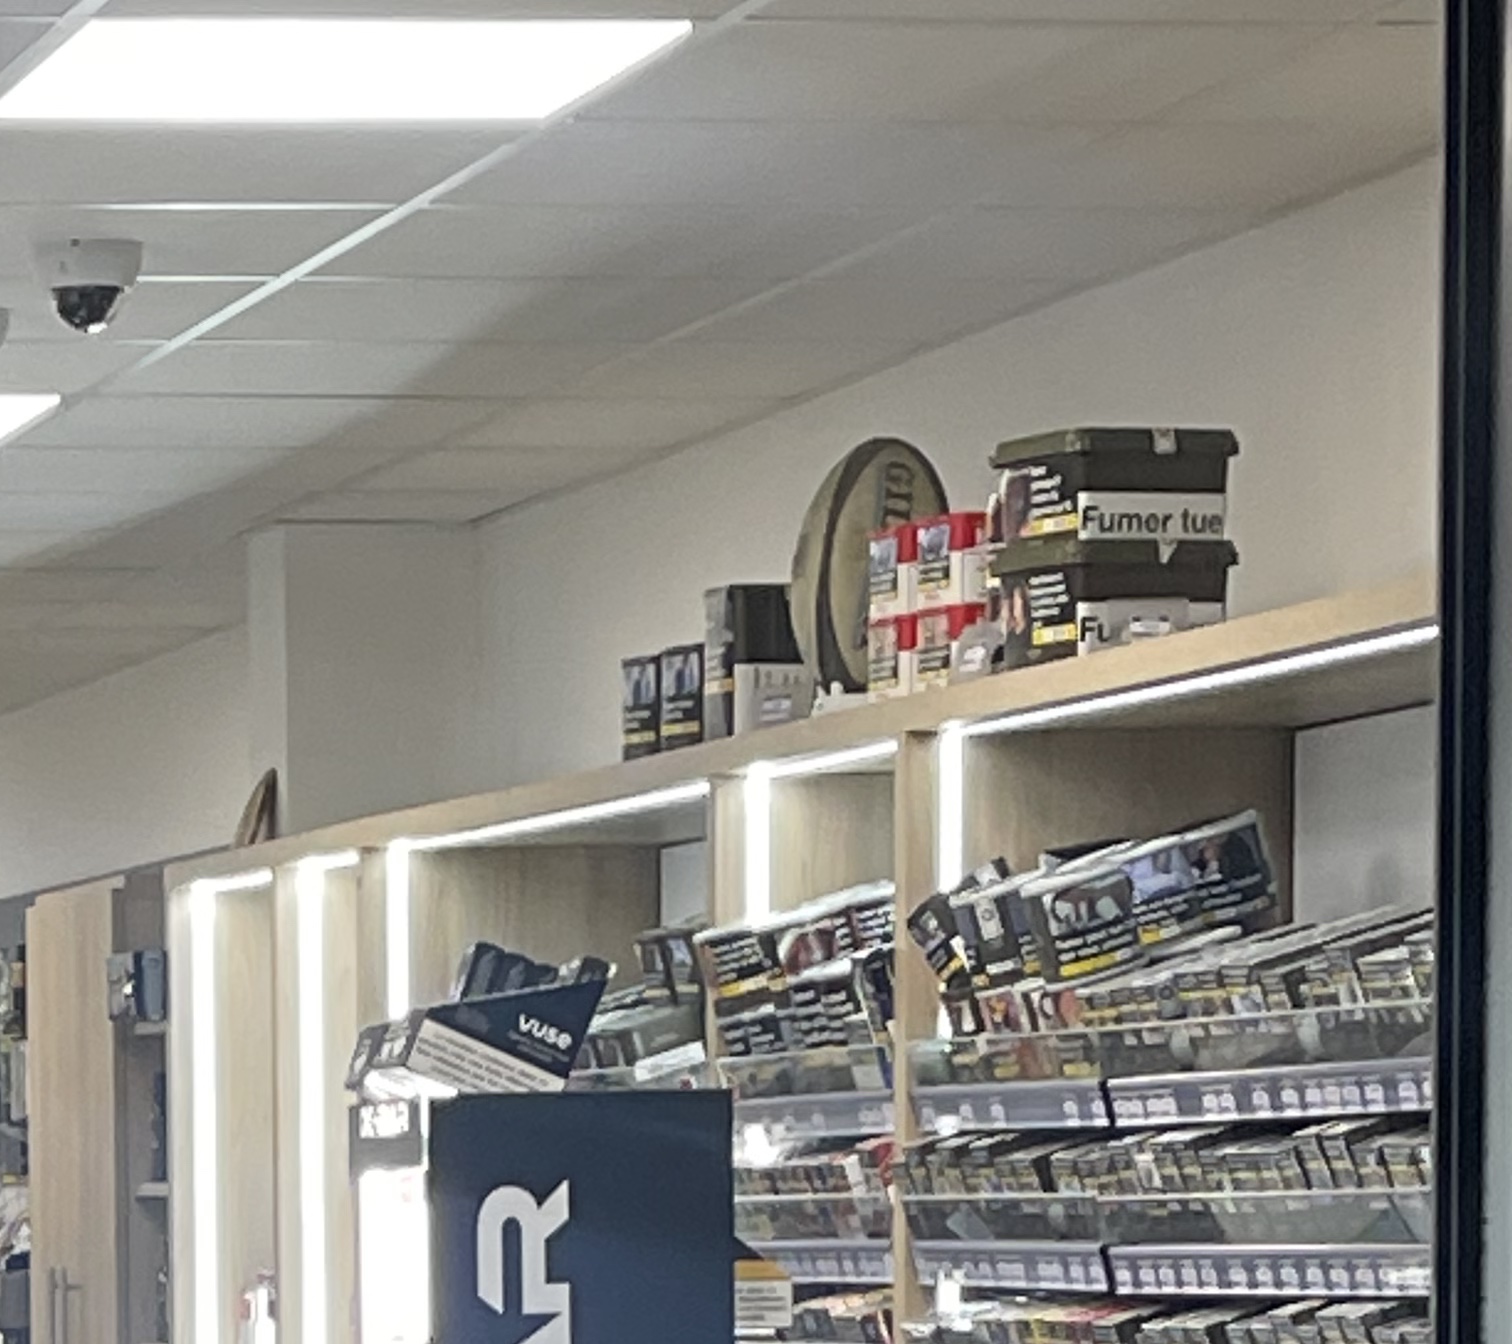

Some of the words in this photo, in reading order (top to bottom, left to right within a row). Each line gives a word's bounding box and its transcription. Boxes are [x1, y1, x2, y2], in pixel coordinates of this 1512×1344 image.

[1081, 505, 1171, 534] Fumer
[1181, 508, 1224, 533] tue
[518, 1013, 573, 1050] vuse
